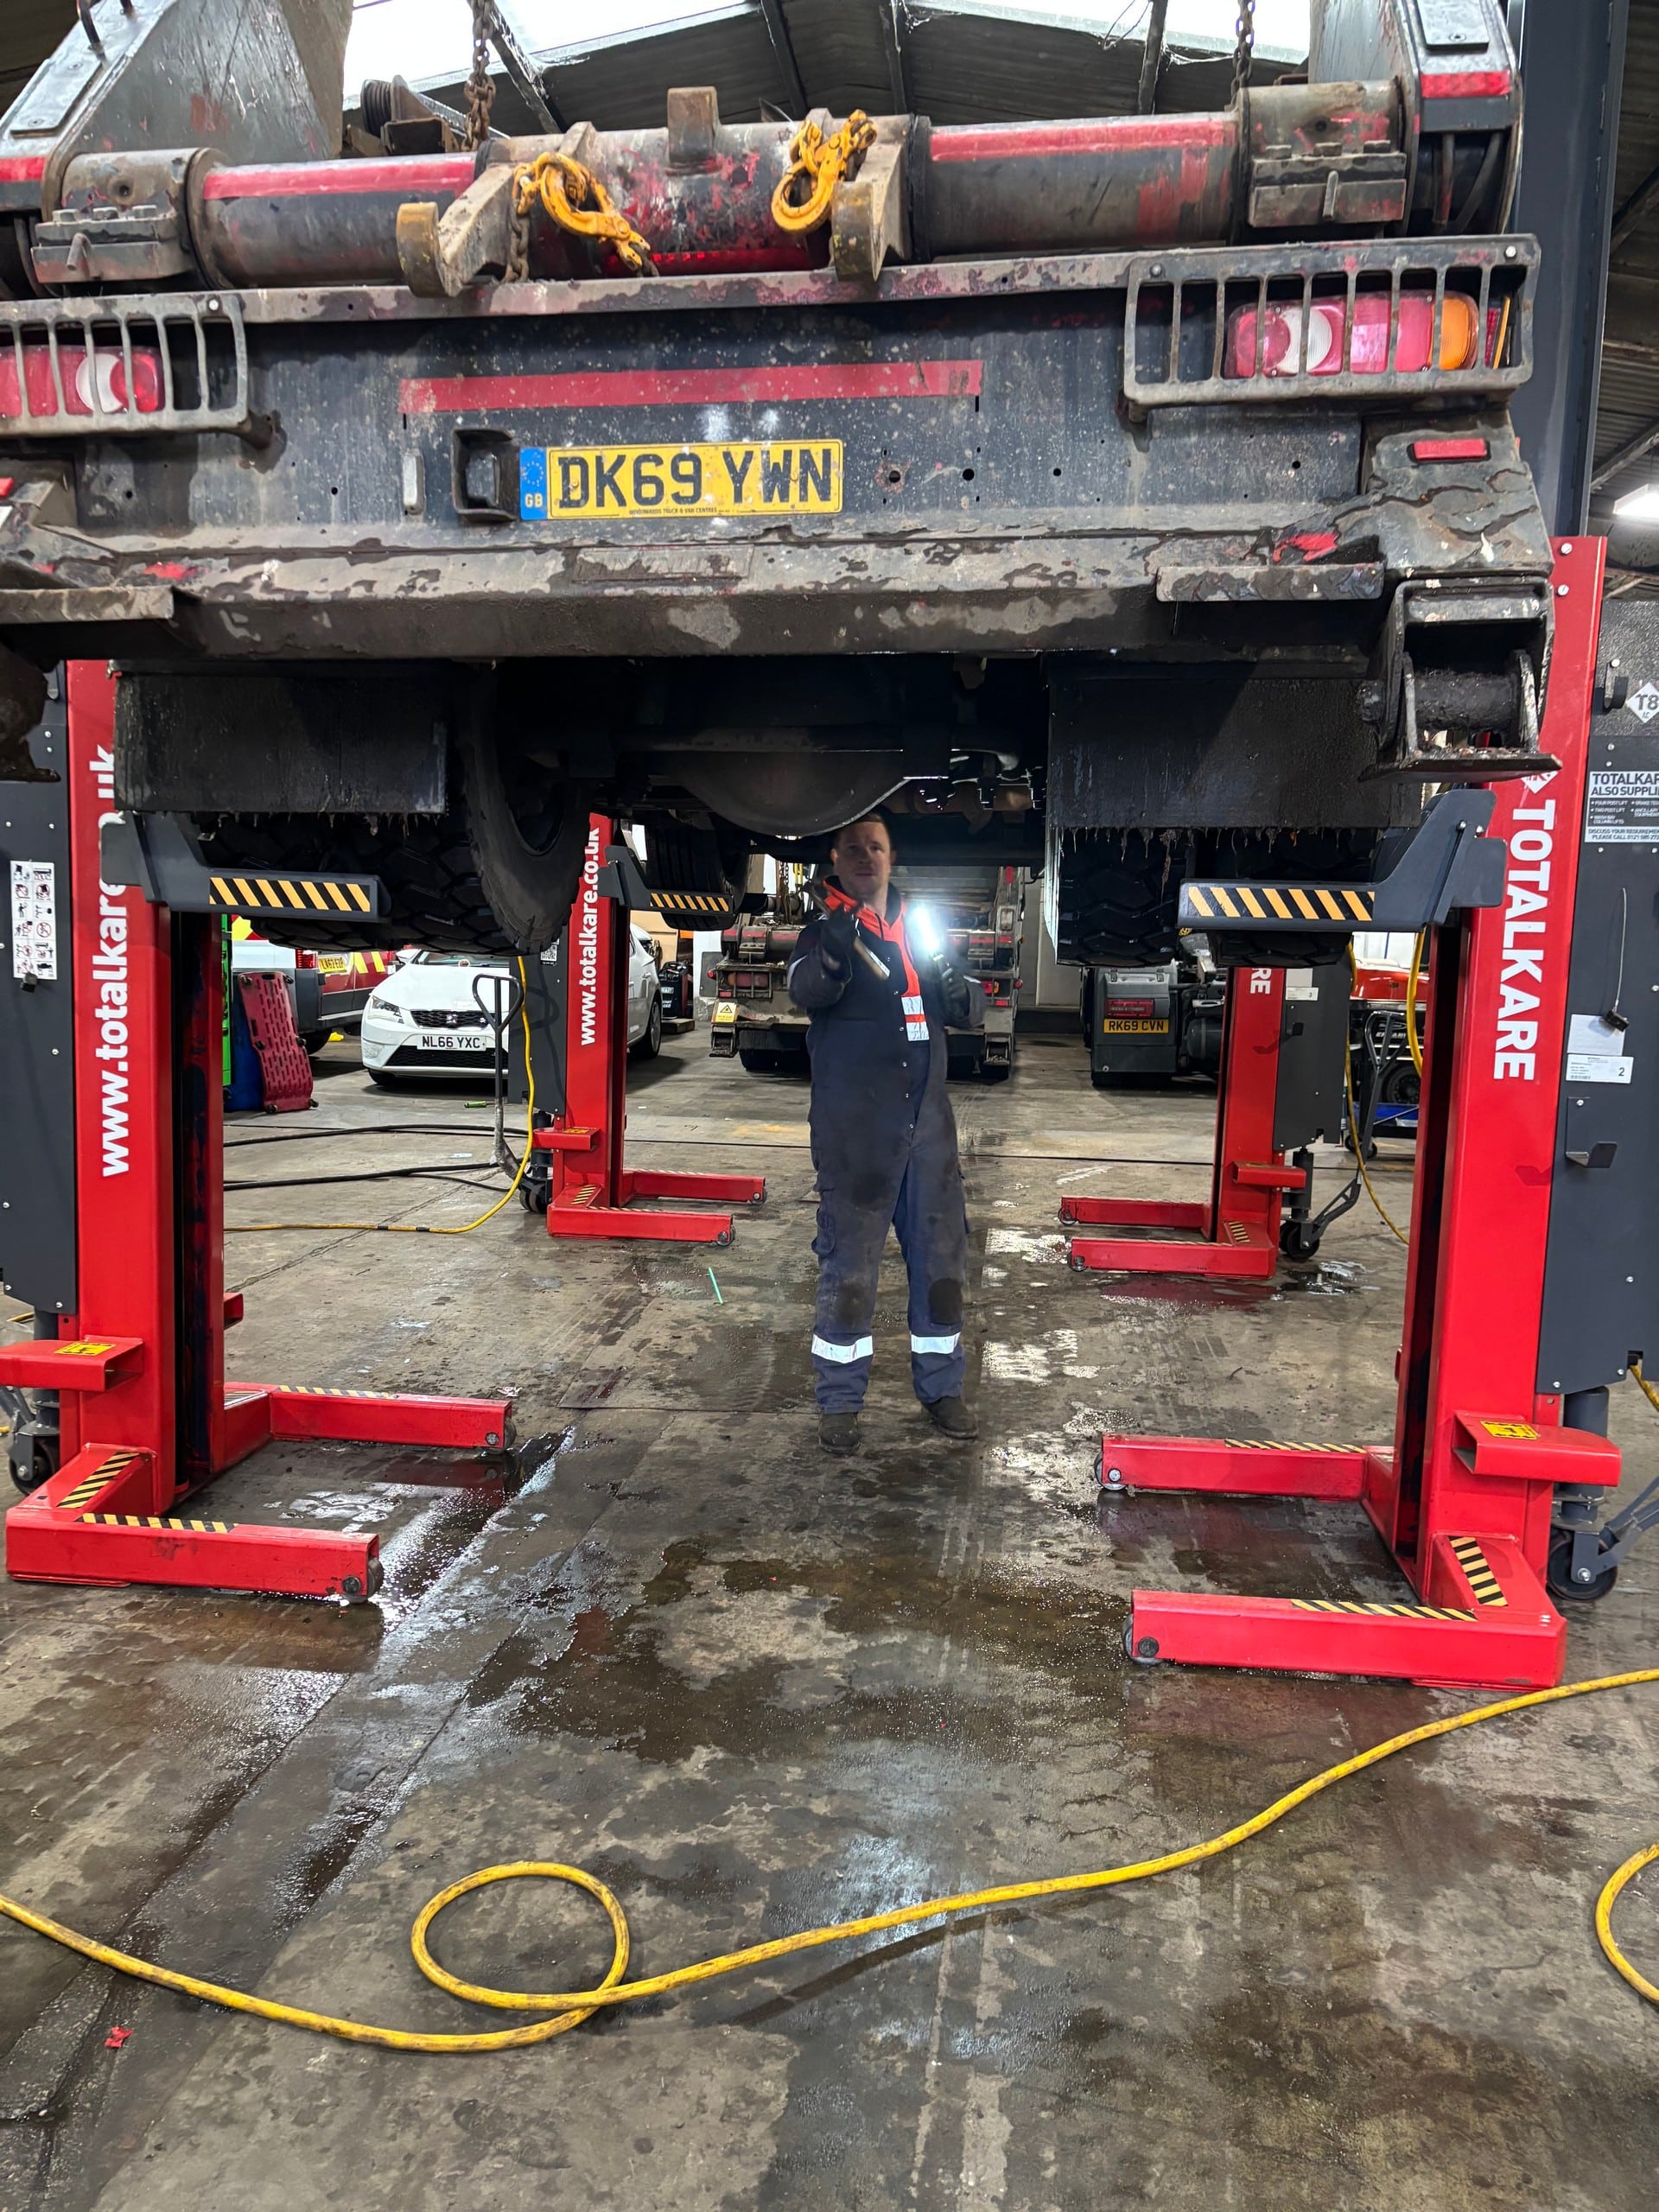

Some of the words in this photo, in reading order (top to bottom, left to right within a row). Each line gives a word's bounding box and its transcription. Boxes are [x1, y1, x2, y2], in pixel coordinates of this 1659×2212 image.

[558, 454, 702, 508] DK69
[723, 448, 832, 504] YWN
[524, 493, 543, 509] GB
[1635, 694, 1659, 710] T8
[1591, 786, 1619, 796] ALSO
[1493, 799, 1555, 1081] TOTALKARE
[1109, 1020, 1138, 1031] RK69
[1141, 1020, 1164, 1031] CVN
[422, 1036, 454, 1048] NL66
[457, 1037, 480, 1048] YXC
[1618, 1067, 1625, 1077] 2
